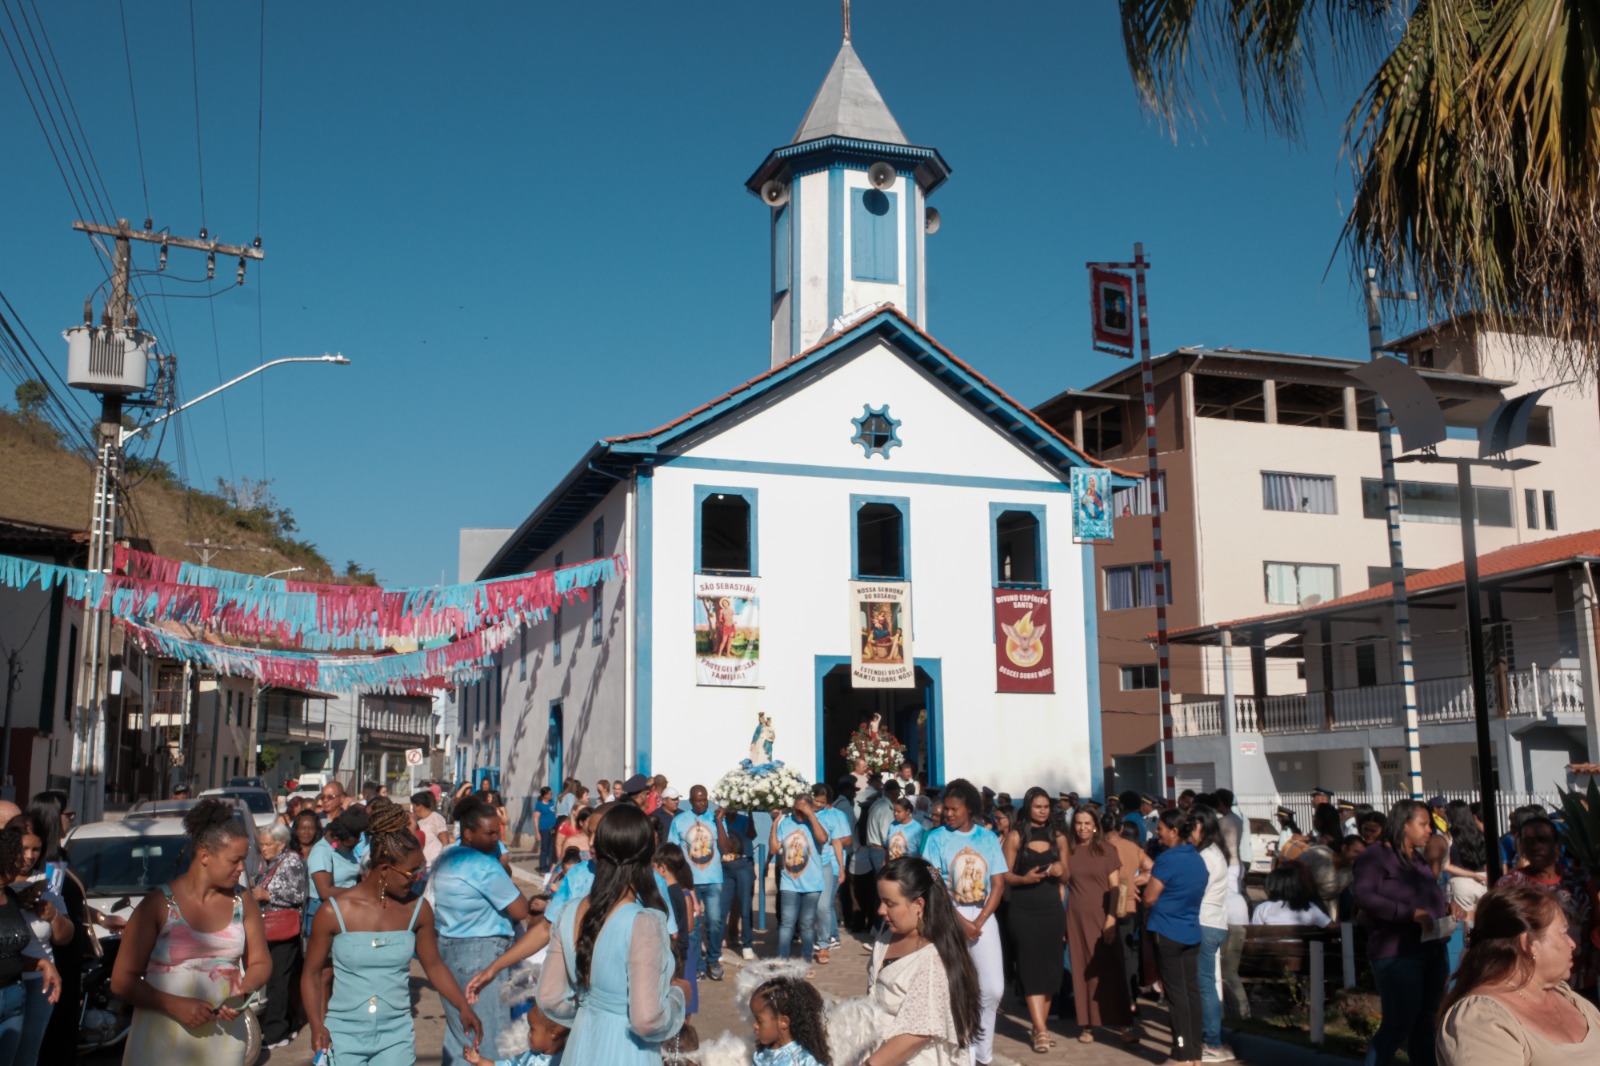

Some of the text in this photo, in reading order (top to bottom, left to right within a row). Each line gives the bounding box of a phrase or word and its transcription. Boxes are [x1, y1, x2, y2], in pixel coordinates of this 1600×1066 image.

[700, 582, 714, 591] SÃO
[877, 587, 904, 595] SENHORA
[873, 592, 897, 600] ROSÁRIO
[996, 594, 1048, 605] DIVINO ESPÍRITO
[701, 657, 757, 672] PROTEGEI NOSSA
[853, 670, 876, 681] MANTO
[860, 666, 907, 676] ESTENDEI VOSSO
[999, 665, 1019, 678] DESCEI
